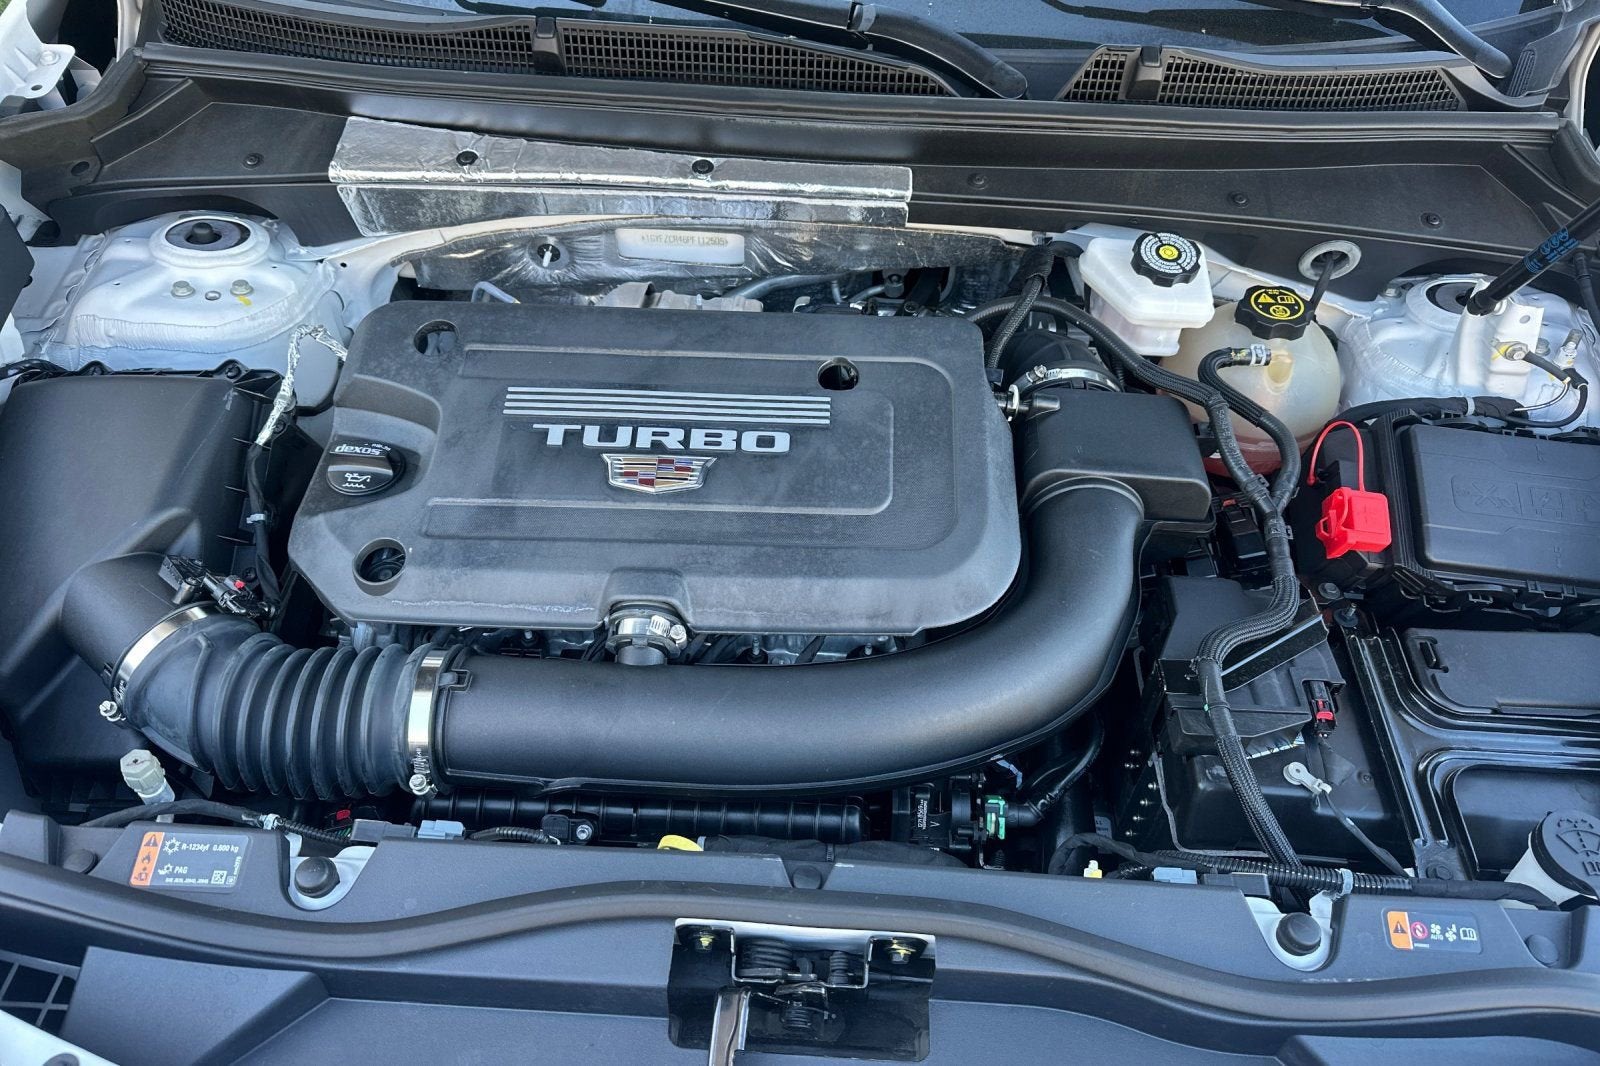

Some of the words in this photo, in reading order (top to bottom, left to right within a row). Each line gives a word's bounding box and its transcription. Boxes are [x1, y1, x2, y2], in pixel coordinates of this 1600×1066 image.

[532, 423, 791, 453] TURBO
[334, 443, 384, 456] dexos
[181, 843, 209, 852] R-1234yf
[231, 844, 239, 853] kg
[174, 865, 189, 874] PAG
